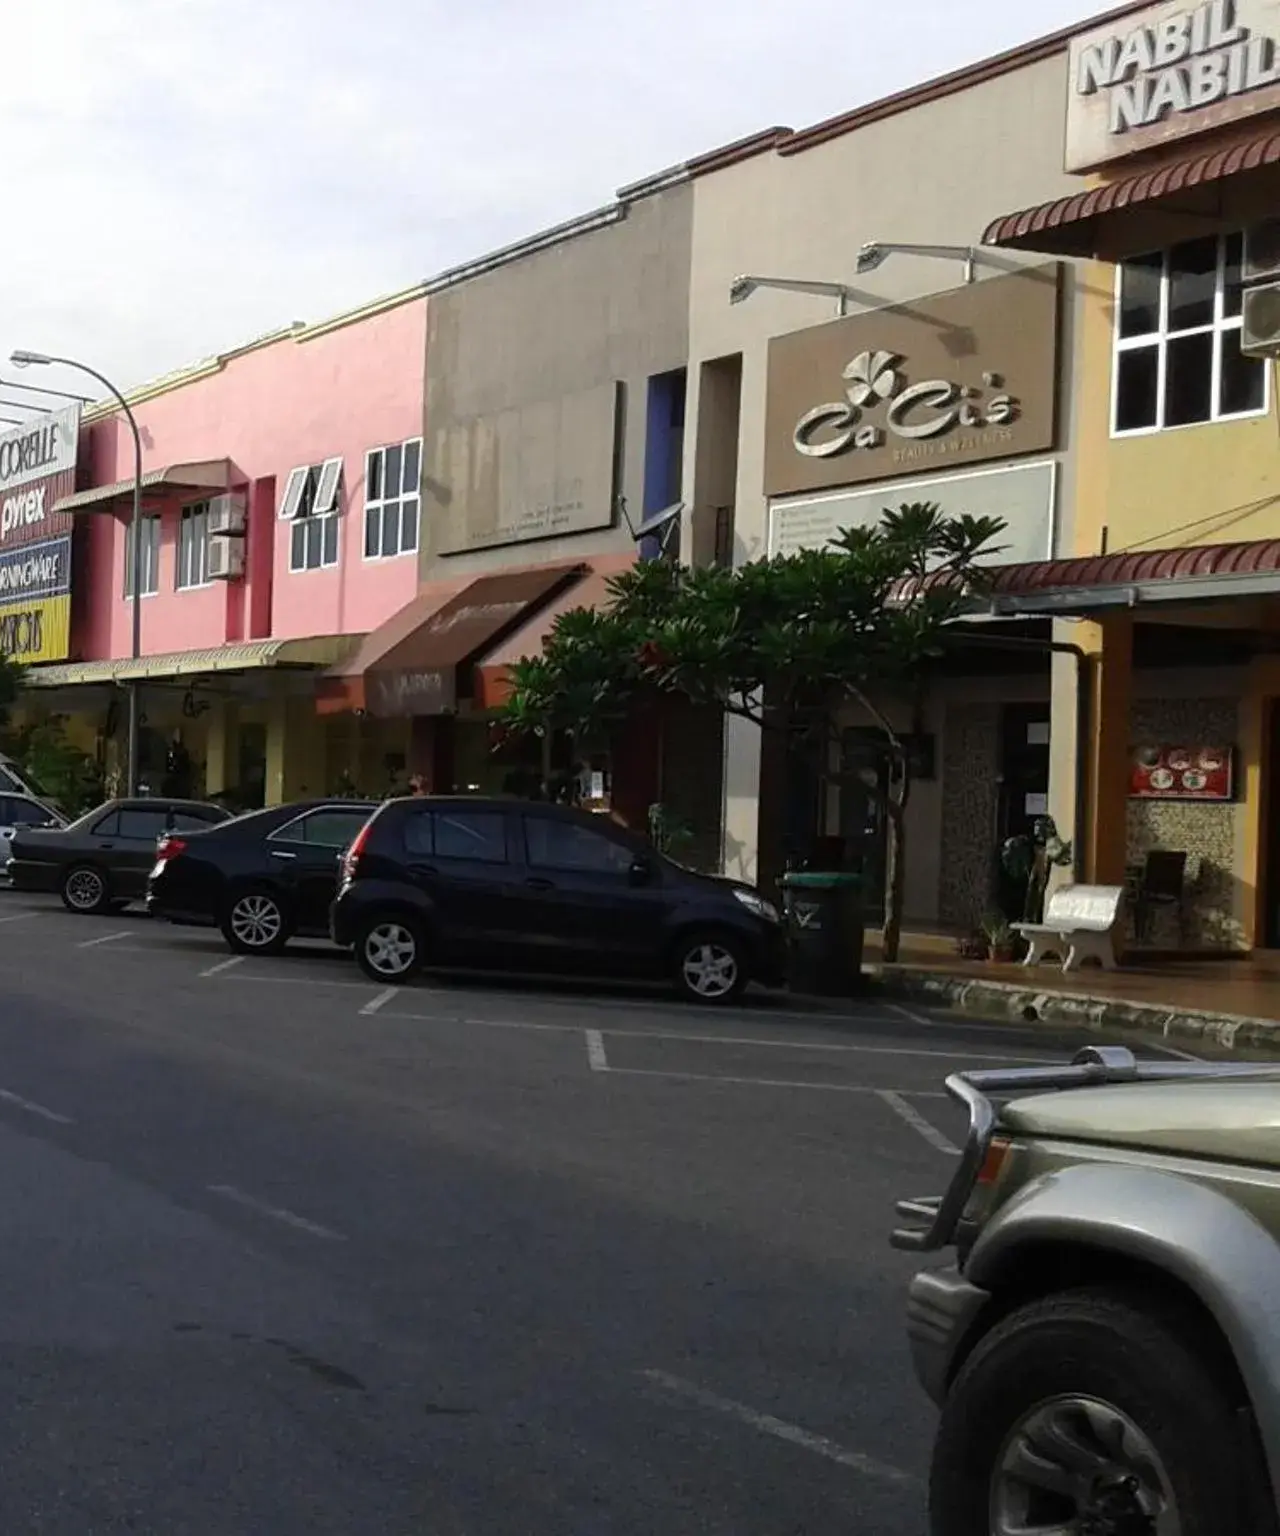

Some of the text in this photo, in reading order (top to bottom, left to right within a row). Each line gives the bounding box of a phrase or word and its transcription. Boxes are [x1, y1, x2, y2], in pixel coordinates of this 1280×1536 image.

[1077, 0, 1240, 94] NABIL
[1109, 36, 1280, 133] NABIL
[1, 486, 45, 540] pyrex
